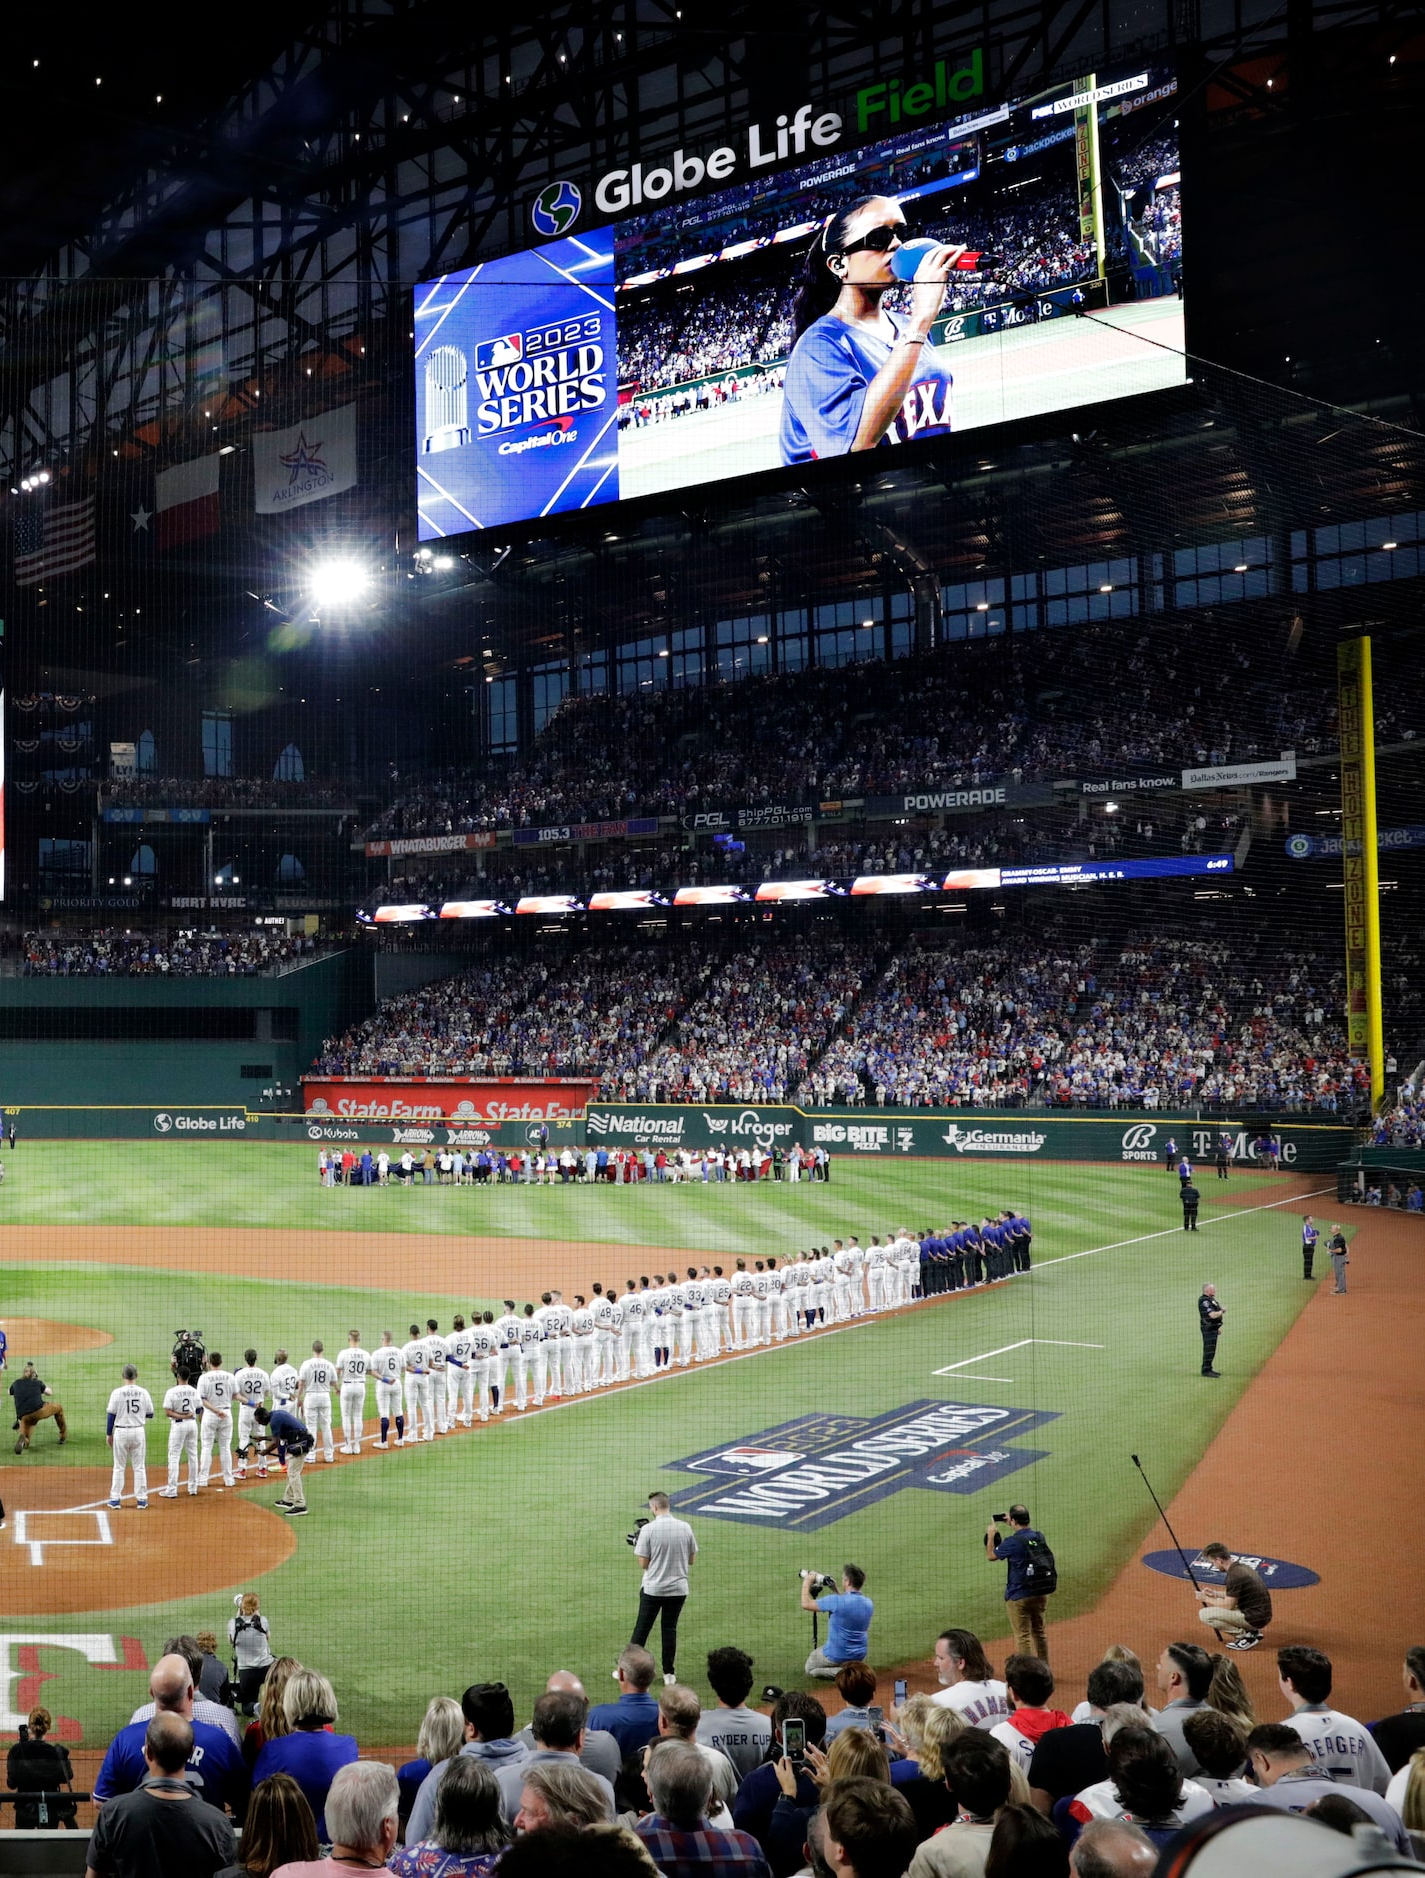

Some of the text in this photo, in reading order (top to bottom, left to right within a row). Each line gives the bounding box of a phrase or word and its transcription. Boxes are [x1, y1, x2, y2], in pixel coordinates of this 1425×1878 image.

[1057, 78, 1144, 110] WORLD SERIES
[594, 146, 737, 214] Globe
[748, 104, 843, 168] Life
[856, 48, 984, 133] Field
[800, 163, 856, 190] POWERADE
[525, 317, 601, 352] 2023
[476, 344, 604, 400] WORLD
[477, 375, 607, 433] SERIES
[273, 471, 335, 501] ARLINGTON
[1082, 781, 1109, 793] Real
[1112, 779, 1137, 791] fans
[1139, 776, 1176, 789] know.
[903, 787, 1006, 811] POWERADE
[694, 811, 730, 826] PGL
[738, 805, 813, 820] ShipPGL.com
[738, 812, 813, 827] 877.701.1919
[537, 822, 627, 842] 105.3 THE FAN
[390, 835, 467, 855] WHATABURGER
[1060, 866, 1082, 874] EMMY
[1207, 859, 1228, 869] 6:49
[1002, 876, 1028, 885] AWARD
[1028, 875, 1060, 884] WINNING
[53, 897, 140, 908] PRIORITY GOLD
[4, 1107, 21, 1116] 407
[175, 1115, 246, 1130] Globe Life
[245, 1115, 259, 1123] 410
[556, 1120, 572, 1129] 374
[323, 1127, 359, 1139] Kubota
[402, 1129, 428, 1140] ARROW
[459, 1129, 484, 1140] ARROW
[732, 1111, 793, 1146] Kroger
[847, 1126, 889, 1143] BITE
[634, 1134, 681, 1143] Car Rental
[971, 1129, 1044, 1144] Germania
[853, 1142, 881, 1150] PIZZA
[1122, 1151, 1157, 1160] SPORTS
[740, 1280, 752, 1291] 22
[688, 1289, 702, 1300] 33
[600, 1307, 612, 1318] 48
[629, 1303, 642, 1314] 46
[547, 1319, 560, 1331] 52
[582, 1319, 593, 1330] 49
[507, 1327, 519, 1339] 61
[525, 1329, 539, 1341] 54
[456, 1343, 471, 1356] 67
[388, 1357, 396, 1370] 6
[415, 1351, 423, 1364] 3
[348, 1361, 365, 1374] 30
[313, 1370, 326, 1384] 18
[215, 1382, 224, 1397] 5
[244, 1380, 262, 1394] 32
[125, 1399, 140, 1414] 15
[182, 1398, 190, 1412] 2
[767, 1418, 871, 1451] 2023
[697, 1404, 1011, 1518] WORLD SERIES
[711, 1734, 771, 1747] RYDER CUP
